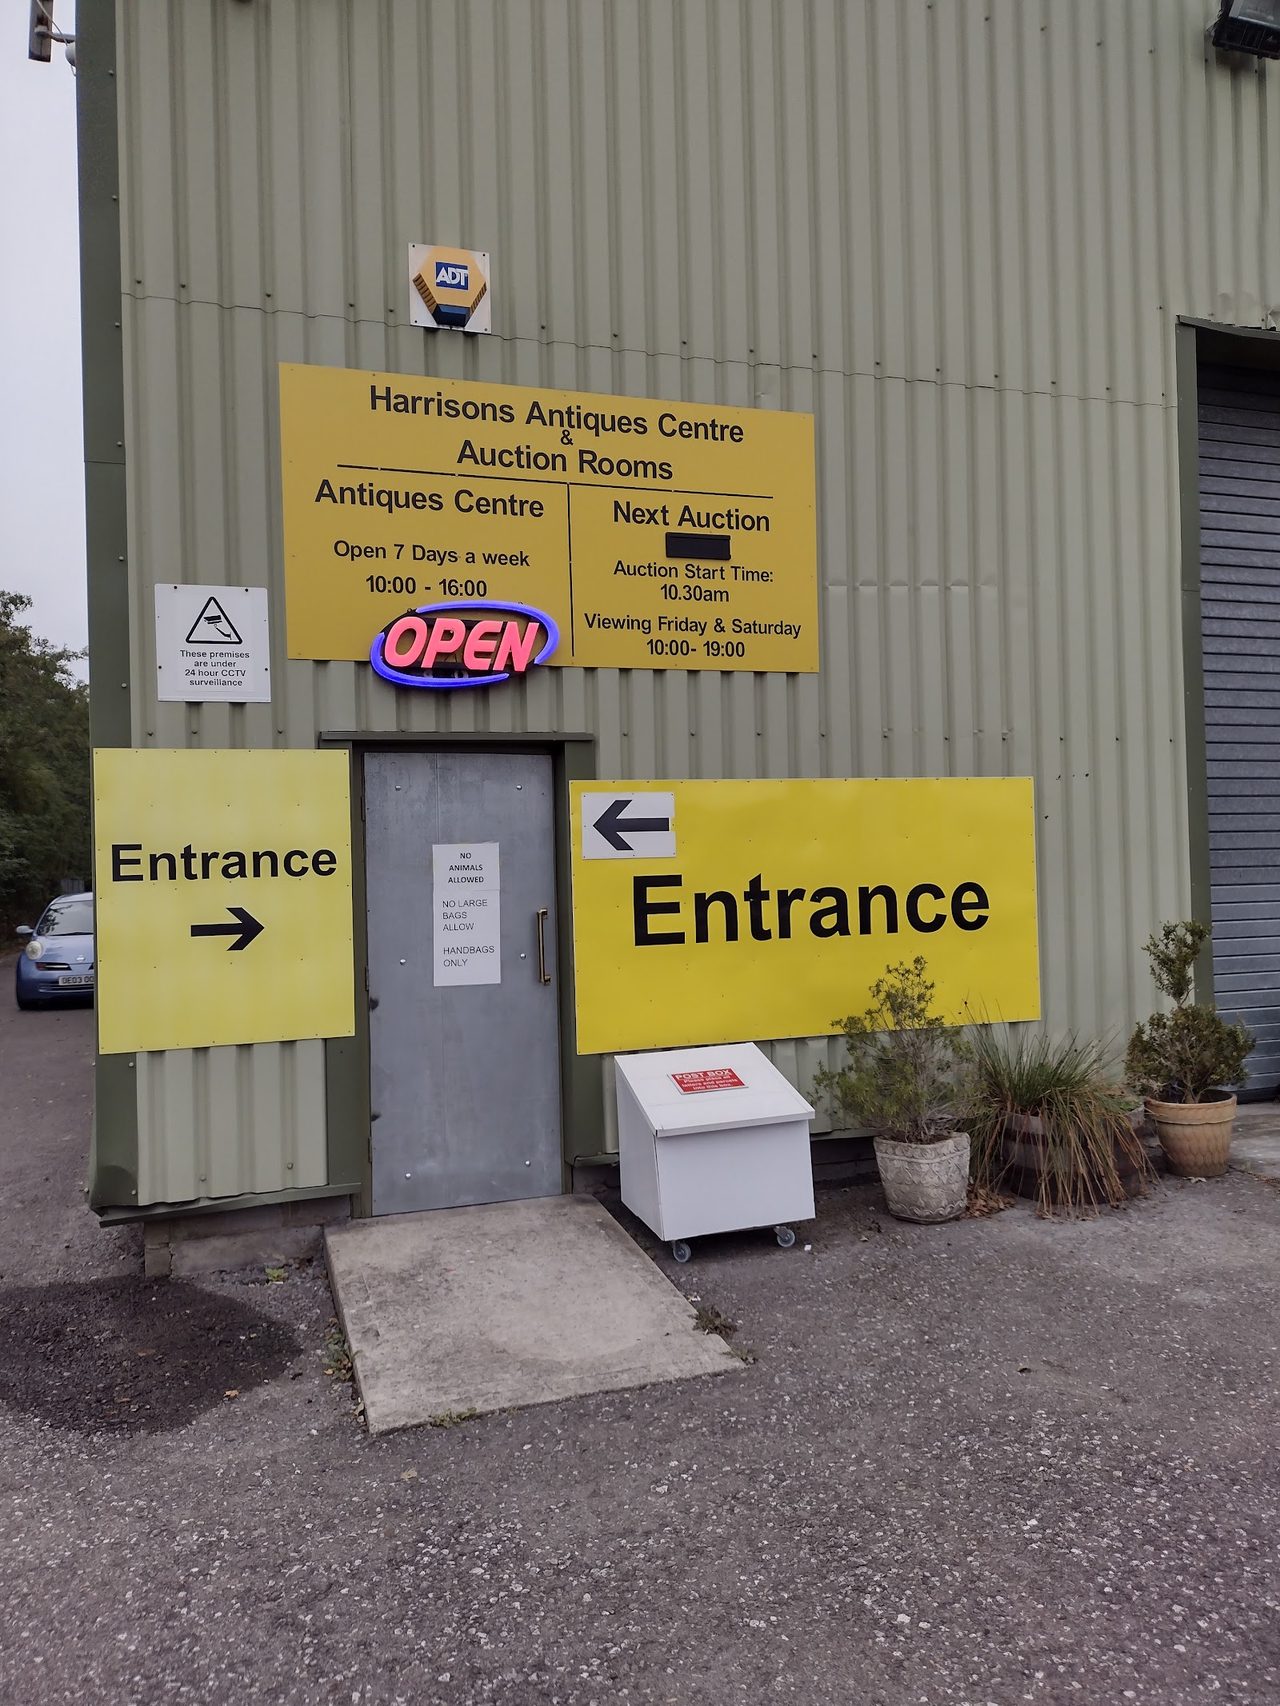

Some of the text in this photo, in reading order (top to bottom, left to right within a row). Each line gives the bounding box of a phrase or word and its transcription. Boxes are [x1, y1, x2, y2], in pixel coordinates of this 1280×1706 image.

[436, 267, 468, 286] ADT
[370, 385, 744, 442] Harrisons Antiques Centre
[560, 429, 573, 445] &
[457, 440, 672, 480] Auction Rooms
[315, 479, 544, 518] Antiques Centre
[613, 501, 770, 531] Next Auction
[334, 540, 530, 566] Open 7 Days a week
[614, 560, 773, 582] Auction Start Time:
[366, 575, 416, 594] 10:00
[439, 579, 487, 597] 16:00
[660, 584, 729, 602] 10.30am
[584, 613, 801, 639] Viewing Friday & Saturday
[210, 651, 250, 659] premises
[385, 616, 540, 672] OPEN
[703, 641, 745, 657] 19:00
[111, 844, 337, 882] Entrance
[442, 899, 488, 908] NO LARGE
[633, 873, 990, 947] Entrance
[443, 923, 474, 931] ALLOW
[444, 946, 494, 955] HANDBAGS
[444, 959, 468, 967] ONLY
